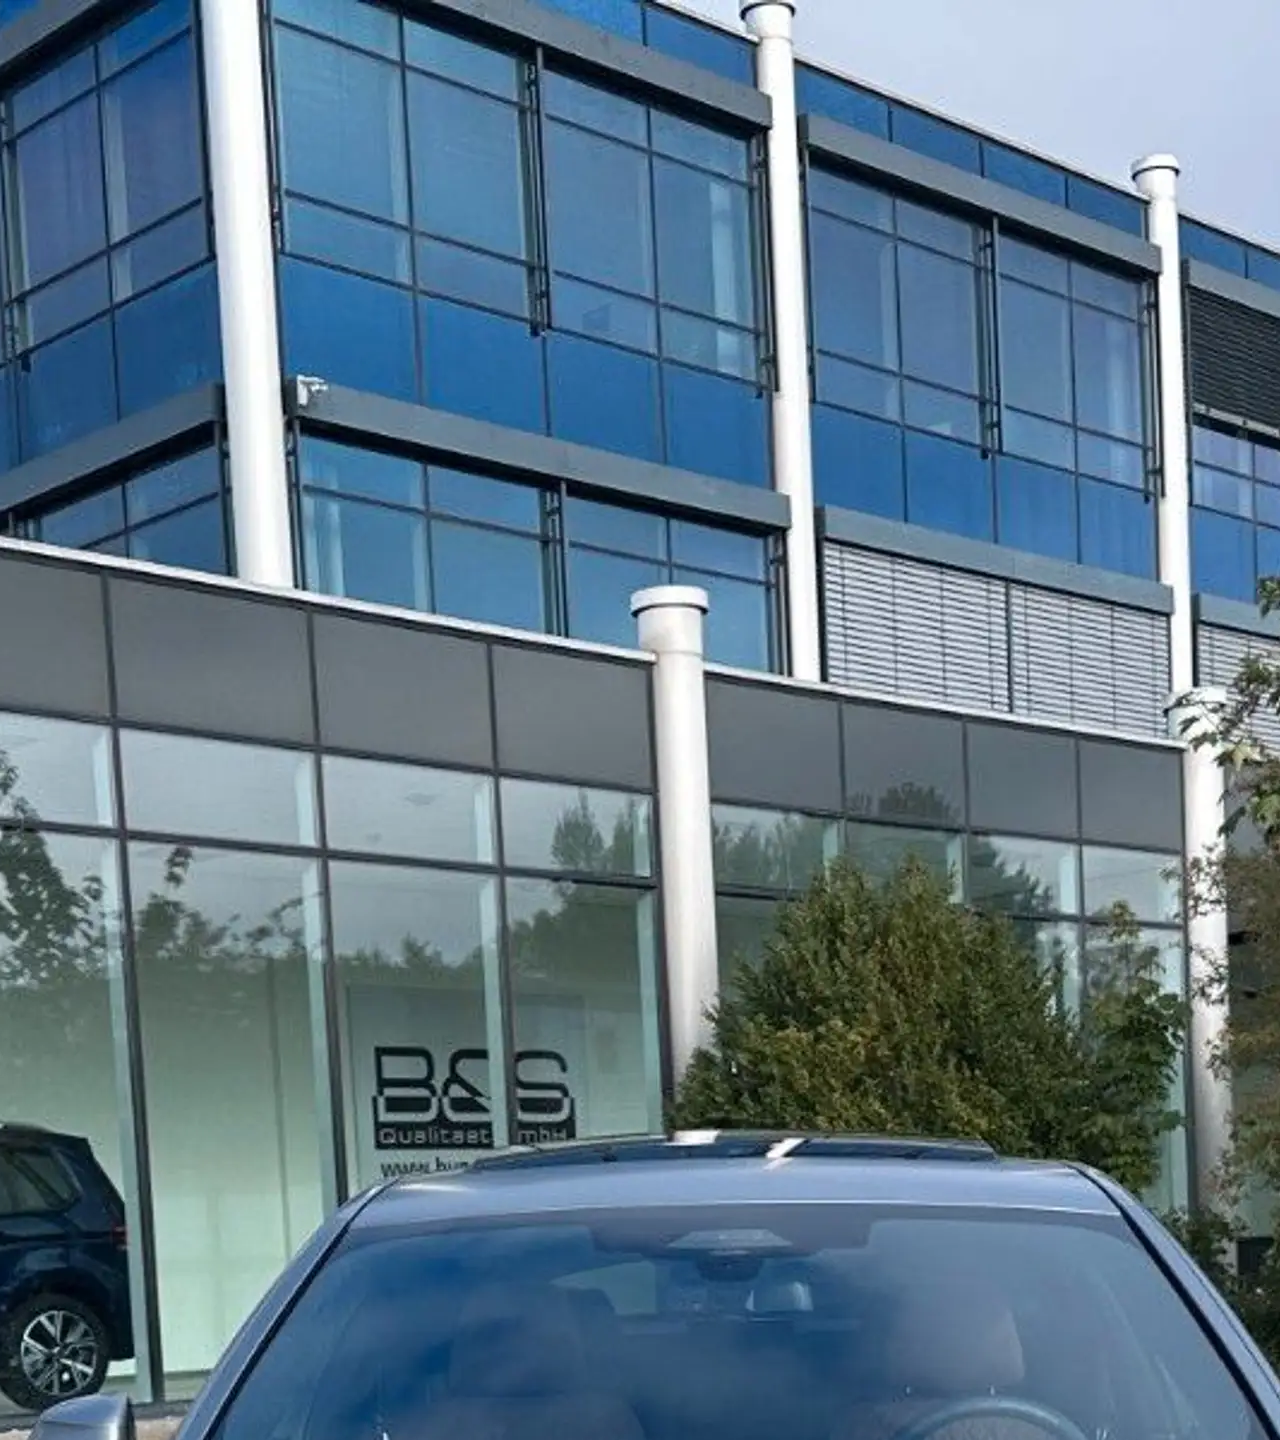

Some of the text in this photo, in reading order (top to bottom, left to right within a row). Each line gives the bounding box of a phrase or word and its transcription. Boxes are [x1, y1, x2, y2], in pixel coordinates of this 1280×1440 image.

[374, 1046, 570, 1123] B&S
[378, 1126, 568, 1145] Qualitaet mbH
